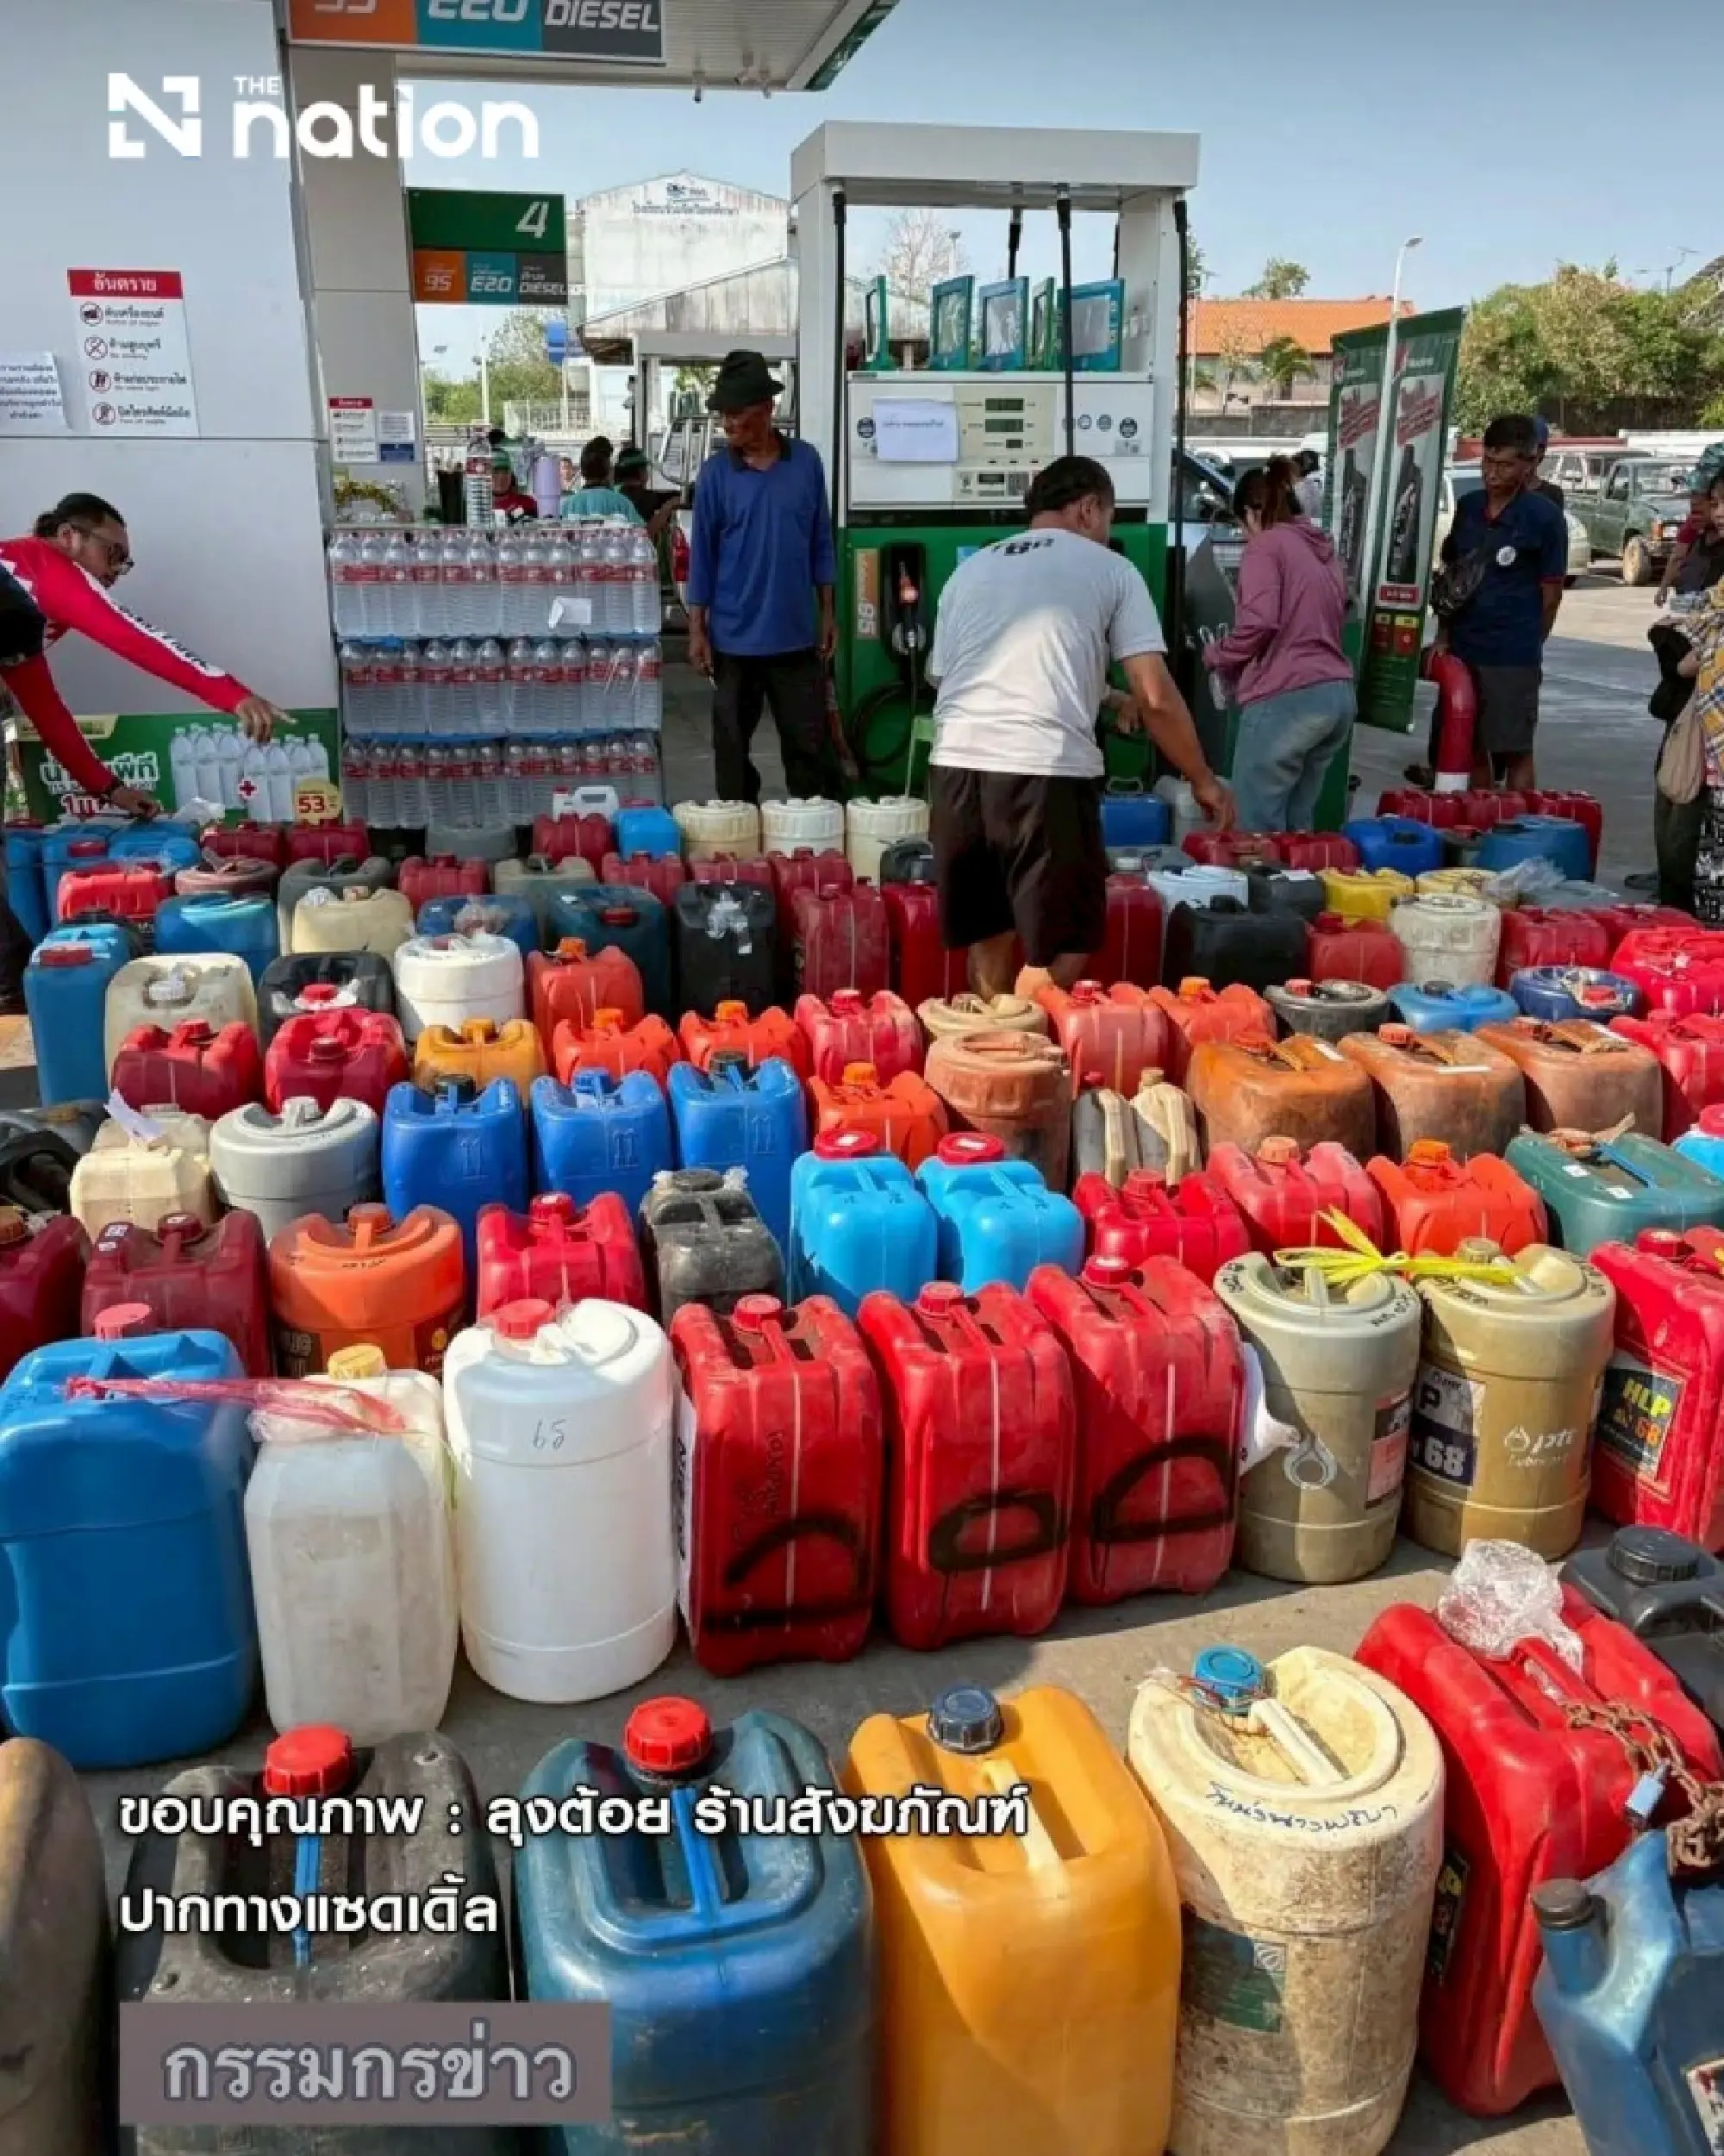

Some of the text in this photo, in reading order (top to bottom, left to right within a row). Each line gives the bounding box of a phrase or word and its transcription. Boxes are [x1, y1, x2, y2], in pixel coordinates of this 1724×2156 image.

[544, 0, 660, 32] DIESEL
[515, 201, 550, 239] 4
[423, 275, 453, 292] 95
[470, 276, 515, 293] E20
[298, 795, 325, 814] 53
[1424, 1435, 1465, 1477] 68
